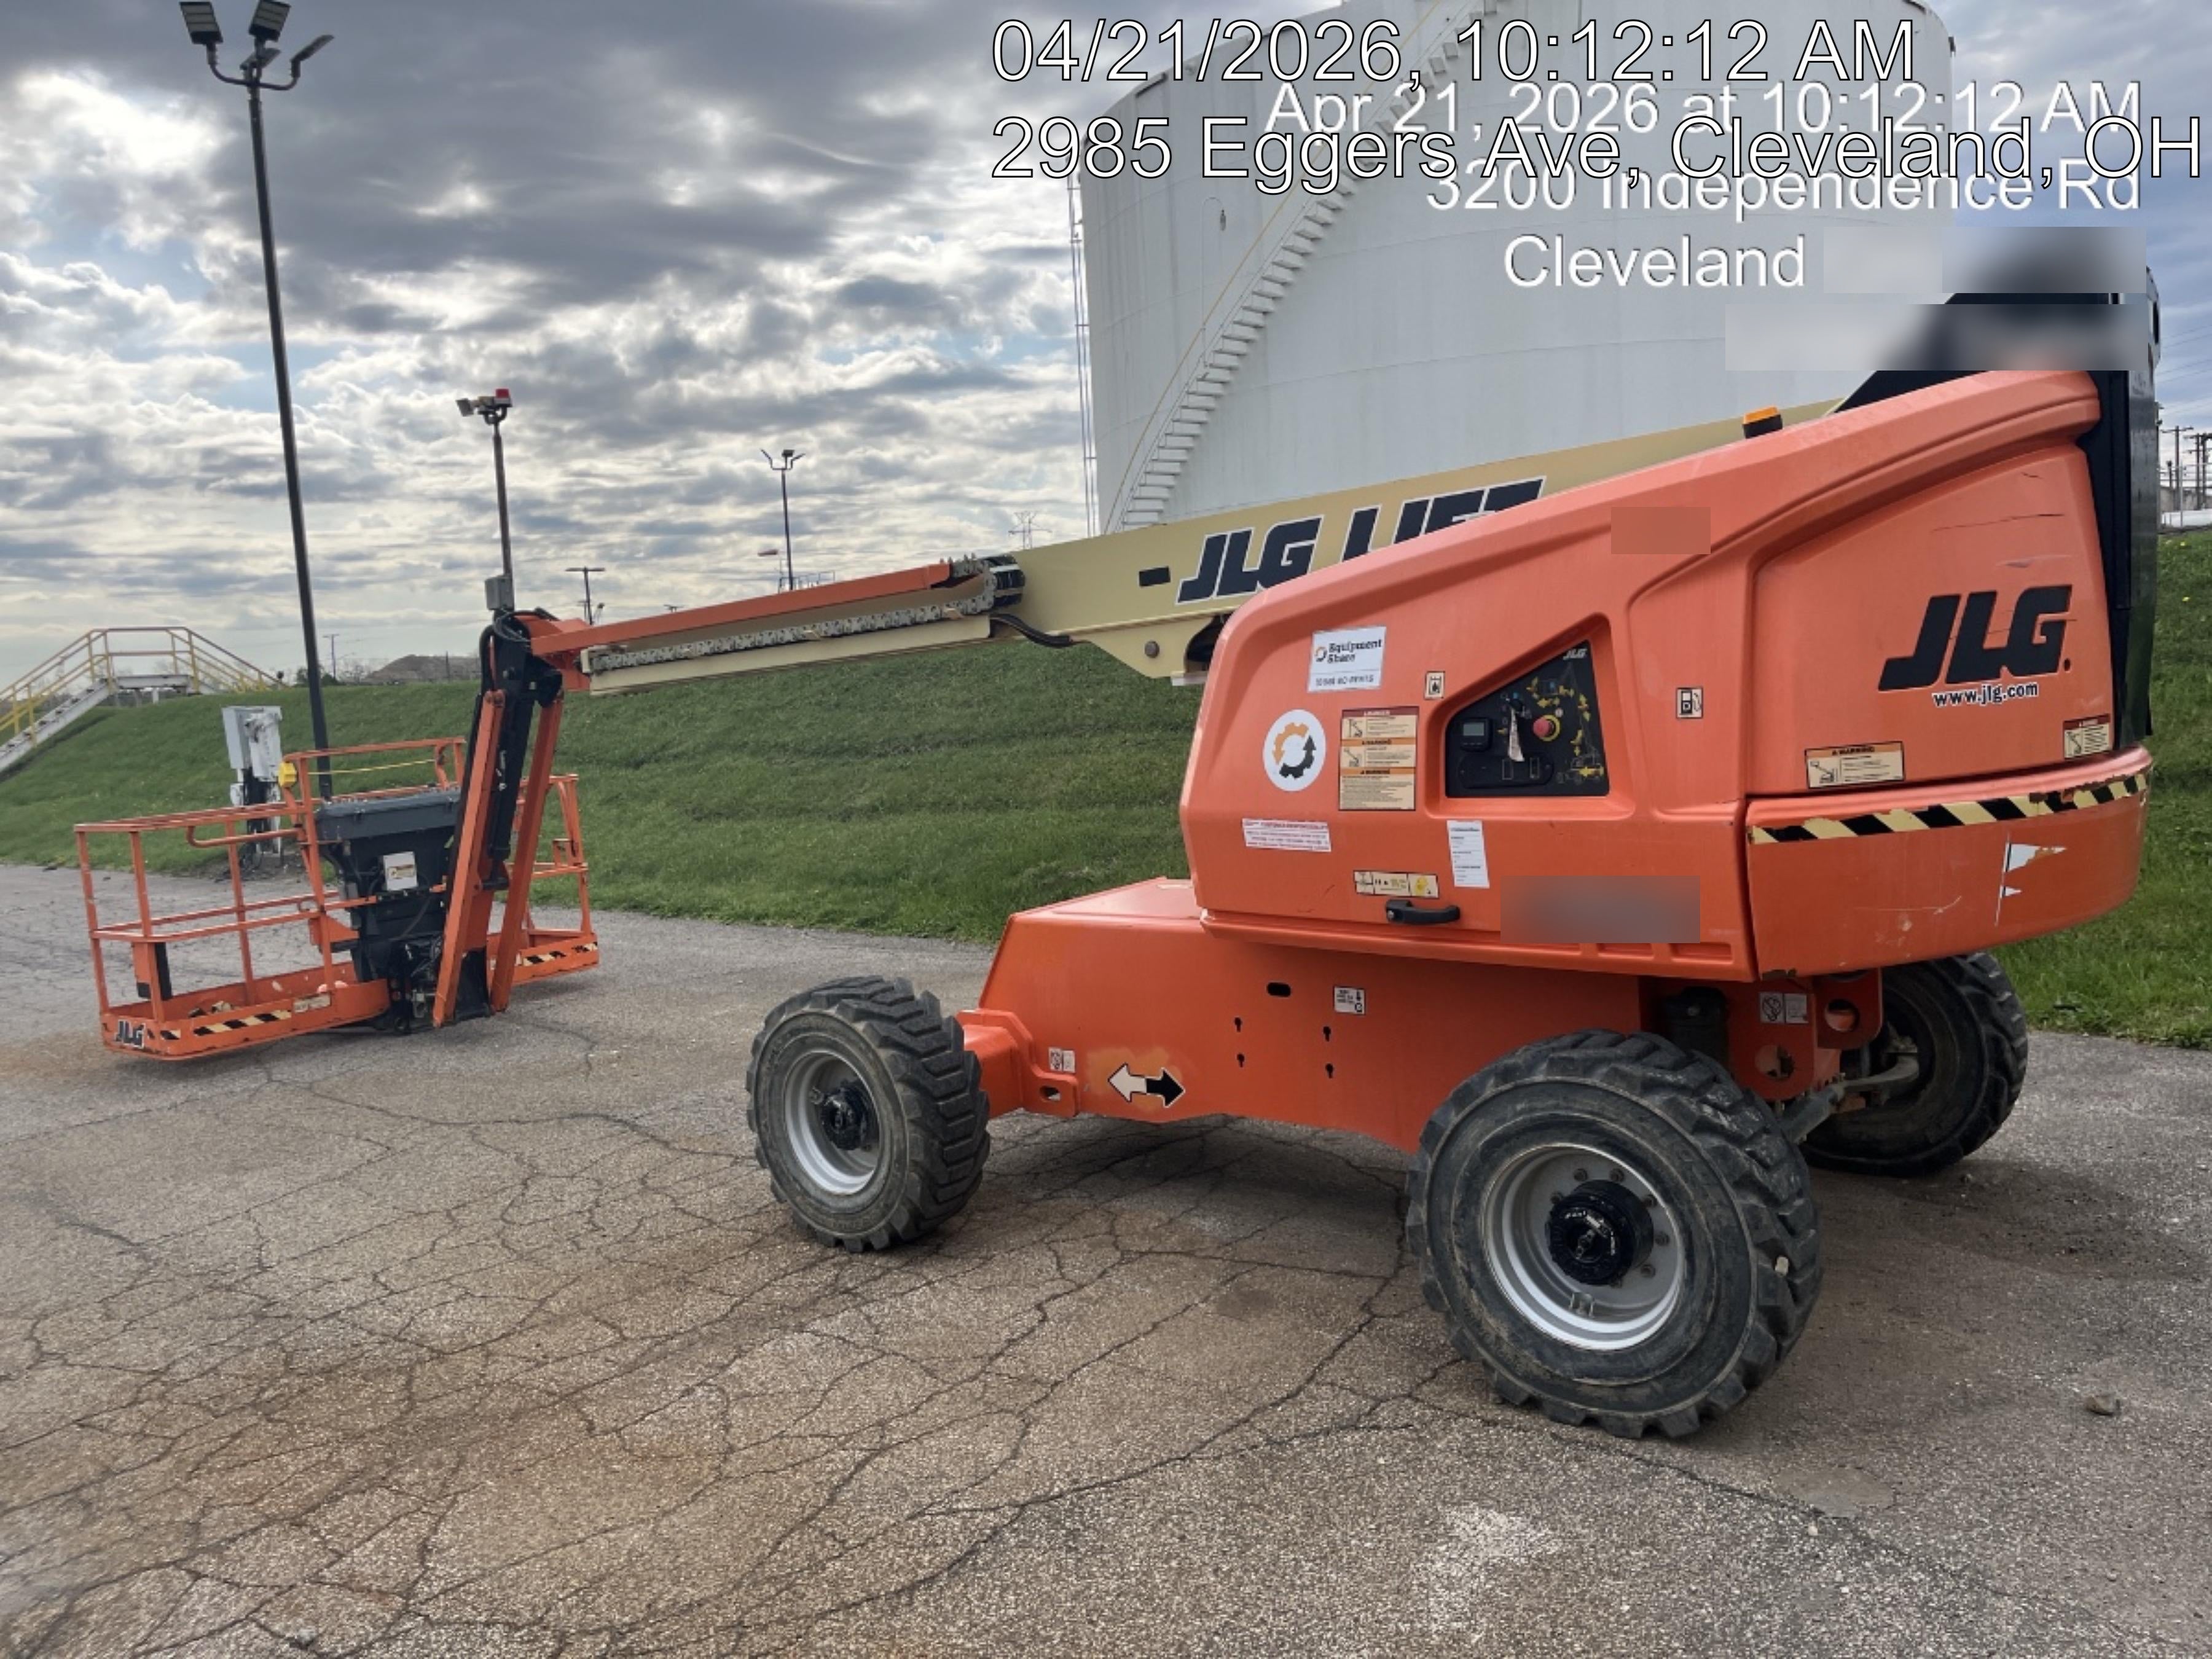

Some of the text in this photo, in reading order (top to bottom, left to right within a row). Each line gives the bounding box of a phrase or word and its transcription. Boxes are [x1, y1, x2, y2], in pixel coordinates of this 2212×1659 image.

[1174, 515, 1325, 605] JLG
[1931, 681, 2040, 708] www.jlg.com
[114, 1019, 146, 1048] JLG
